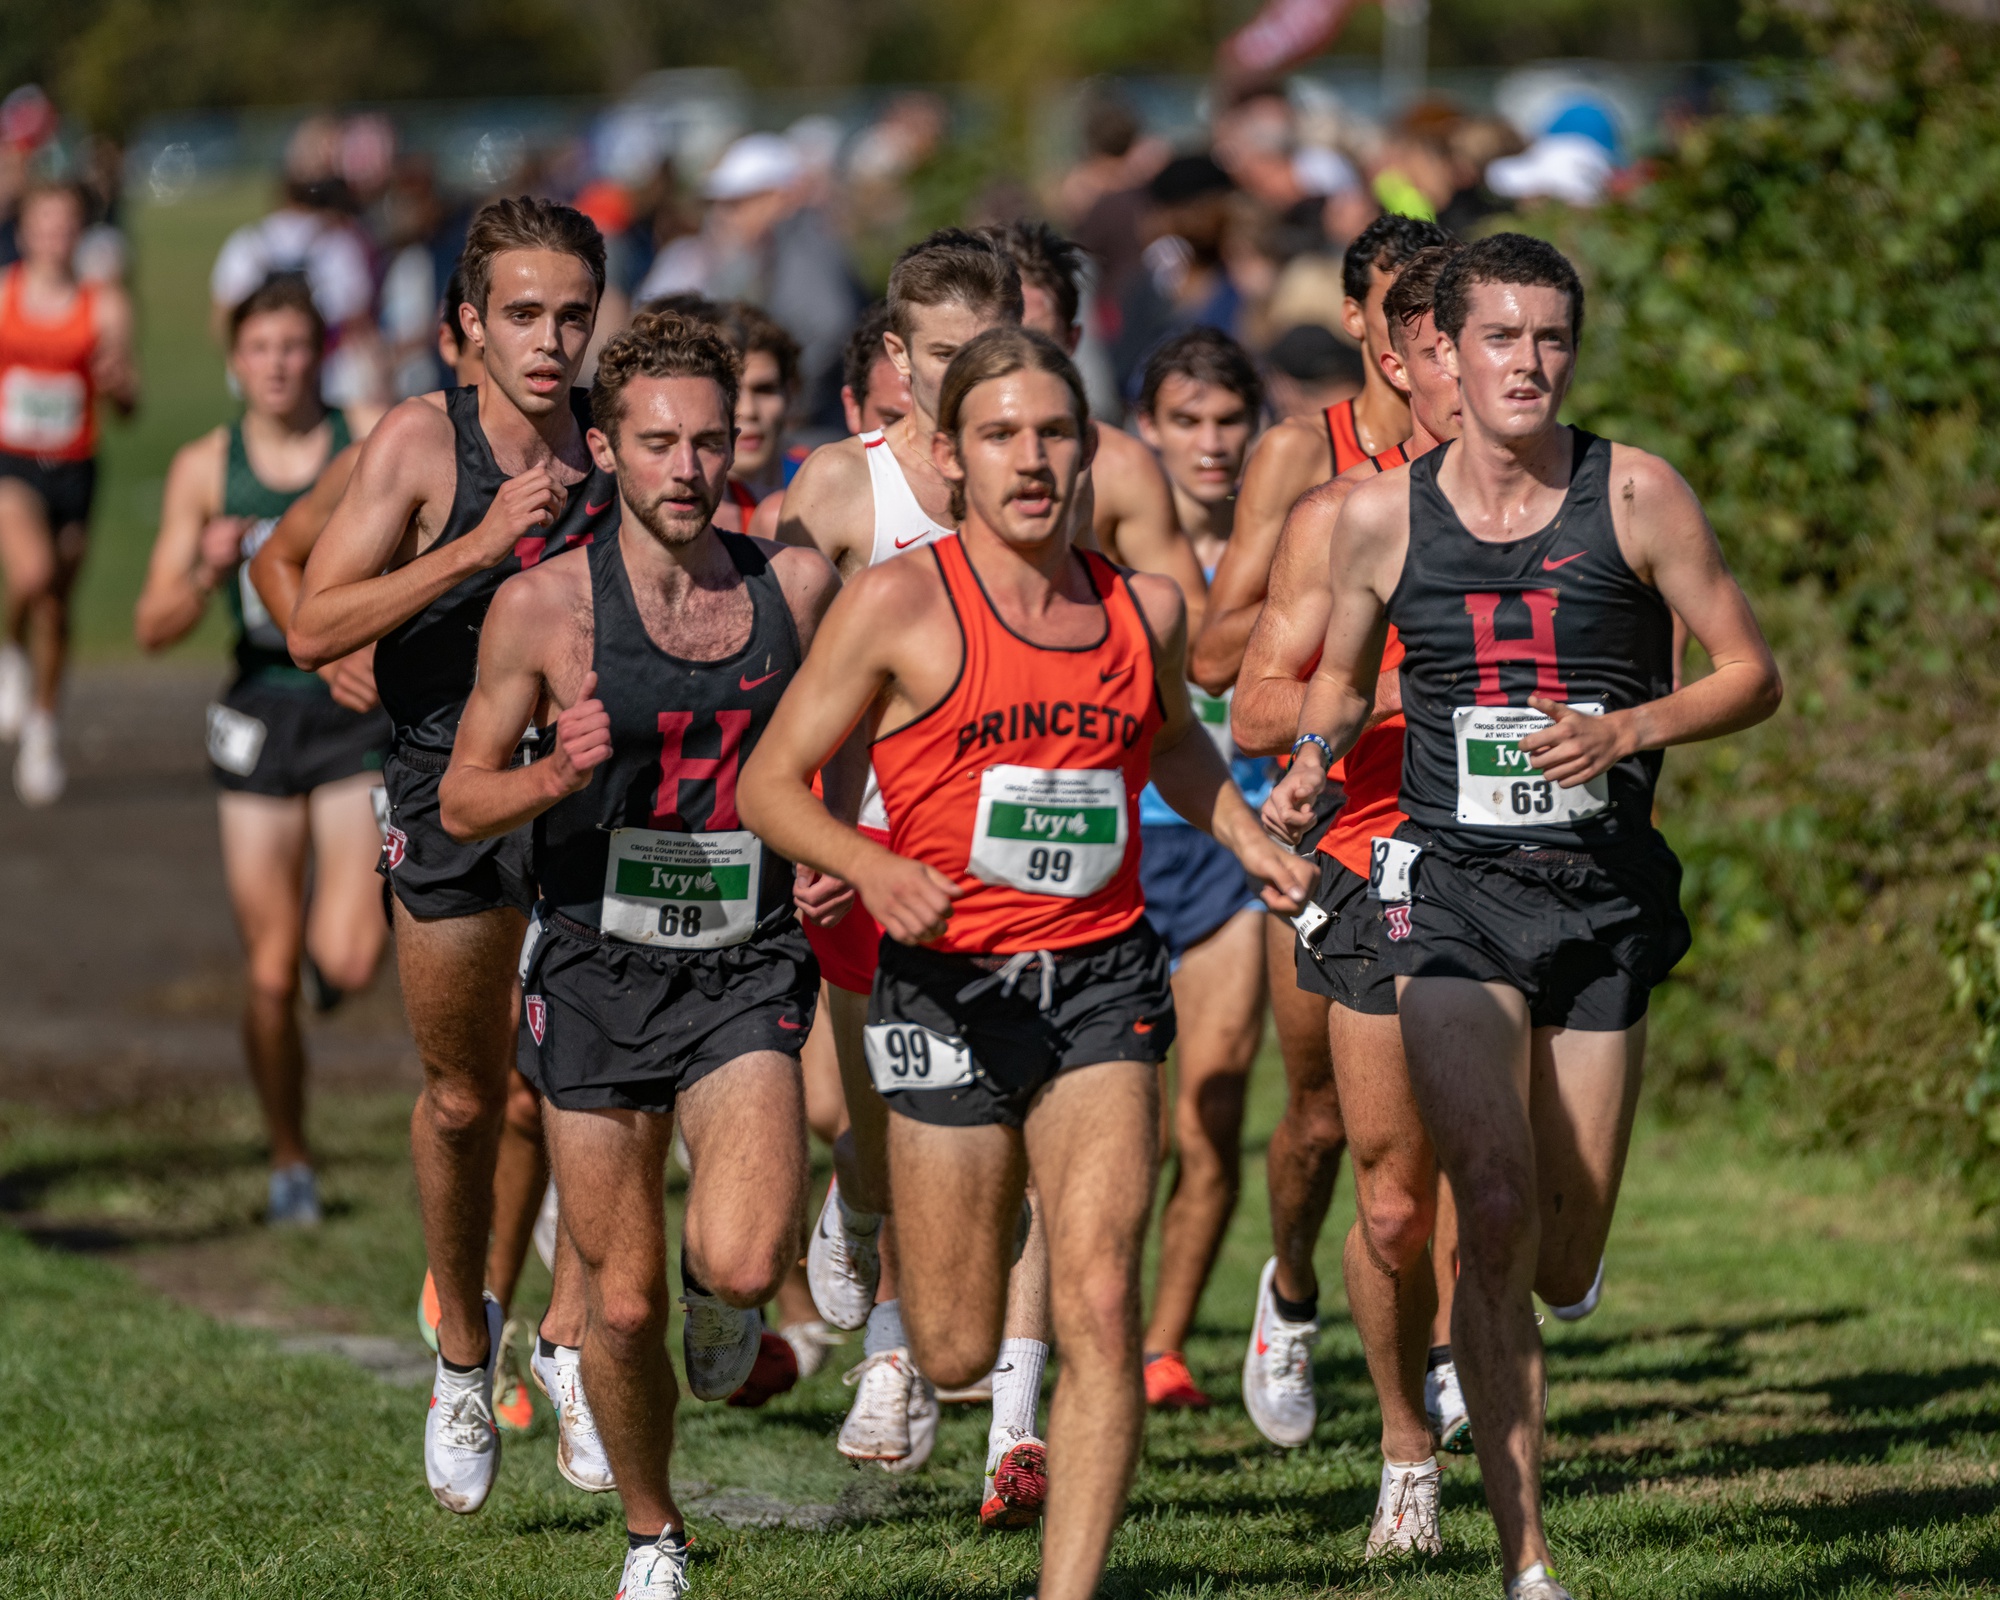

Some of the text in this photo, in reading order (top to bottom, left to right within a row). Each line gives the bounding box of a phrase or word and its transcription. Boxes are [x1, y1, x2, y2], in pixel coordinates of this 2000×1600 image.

[1464, 587, 1569, 706] H
[955, 700, 1143, 759] PRINCETO
[1474, 722, 1495, 730] CROSS
[648, 709, 751, 831] H
[1511, 780, 1554, 815] 63
[1021, 807, 1067, 839] Ivy
[630, 843, 743, 856] CROSS COUNTRY CHAMPIONSHIPS
[656, 839, 718, 849] 2021 HEPTAGONAL
[649, 866, 694, 896] Ivy
[1027, 846, 1074, 883] 99
[658, 903, 702, 938] 68
[885, 1027, 931, 1078] 99
